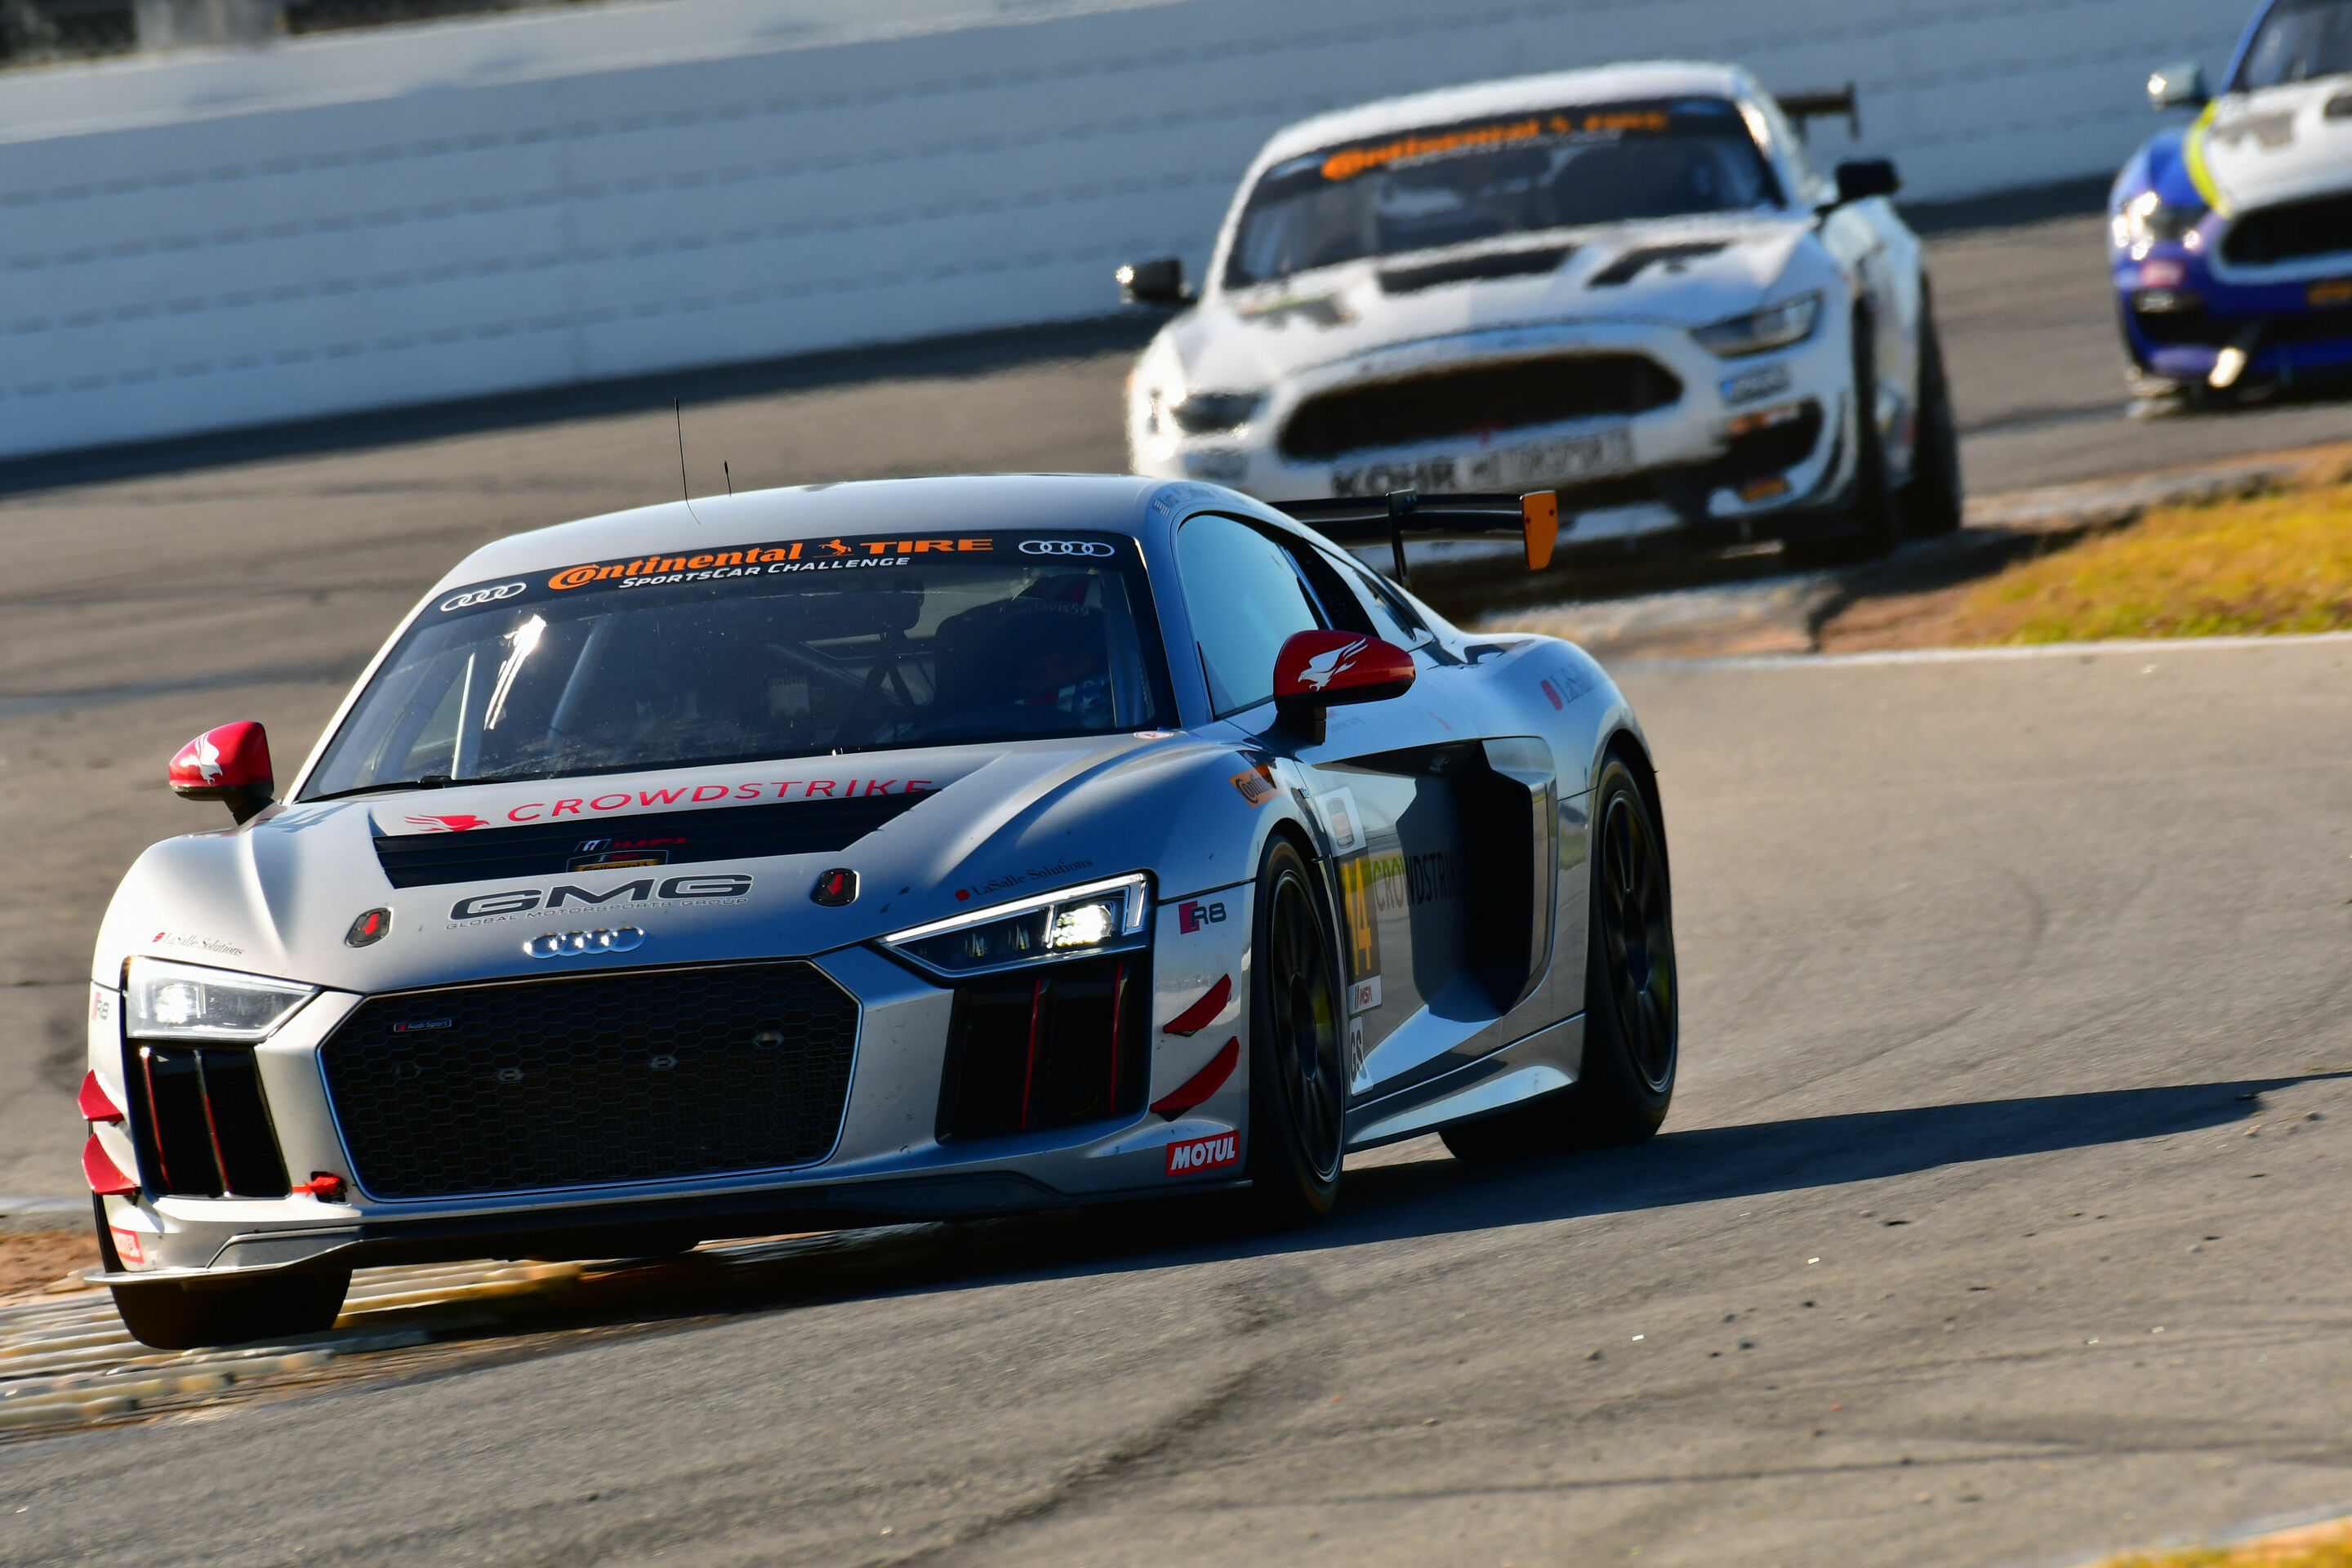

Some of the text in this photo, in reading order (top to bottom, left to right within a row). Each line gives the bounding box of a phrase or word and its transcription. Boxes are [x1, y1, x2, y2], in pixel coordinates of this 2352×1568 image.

[548, 538, 994, 590] Continental TIRE
[618, 556, 911, 590] SPORTSCAR CHALLENGE
[506, 779, 933, 822] CROWDSTRIKE
[970, 857, 1094, 897] LaSalle Solutions
[445, 898, 750, 930] GLOBAL MOTORSPORTS GROUP
[449, 874, 754, 921] GMG
[1187, 902, 1227, 930] R8
[1343, 858, 1373, 977] 14
[198, 937, 245, 956] Solutions
[95, 996, 109, 1020] R8
[1350, 1029, 1368, 1084] GS
[1170, 1136, 1236, 1170] MOTUL
